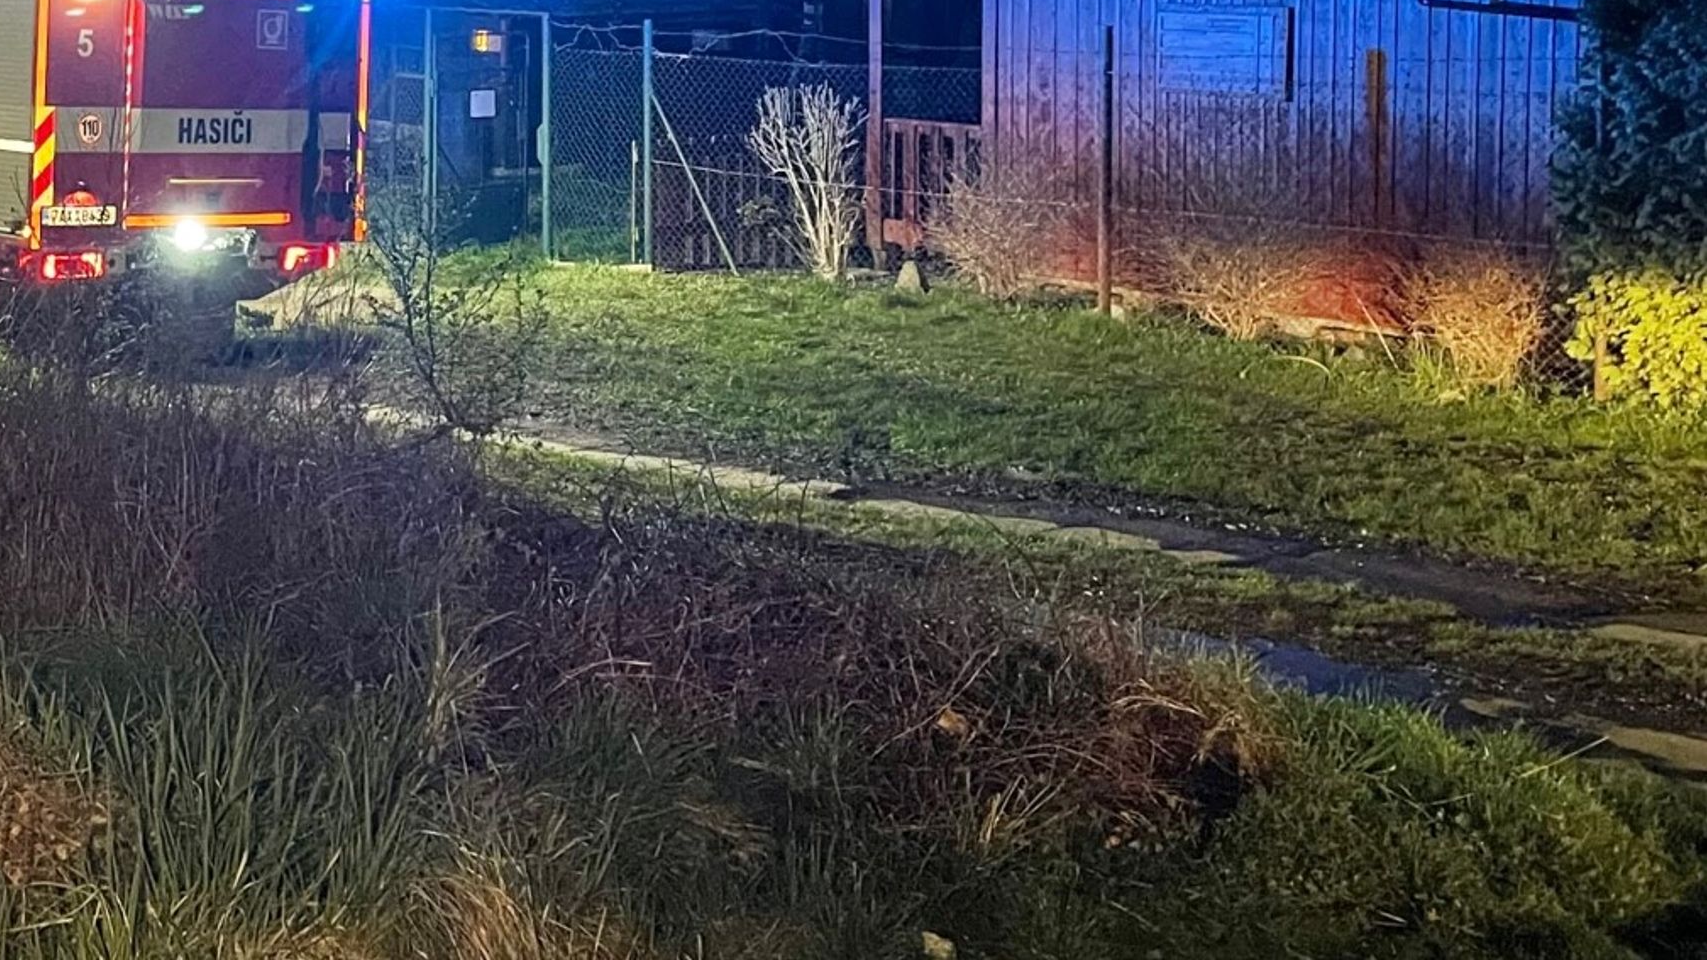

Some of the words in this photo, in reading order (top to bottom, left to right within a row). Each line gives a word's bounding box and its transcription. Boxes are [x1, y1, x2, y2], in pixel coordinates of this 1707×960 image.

[77, 28, 94, 57] 5
[81, 120, 99, 137] 110
[178, 110, 252, 145] HASIČI
